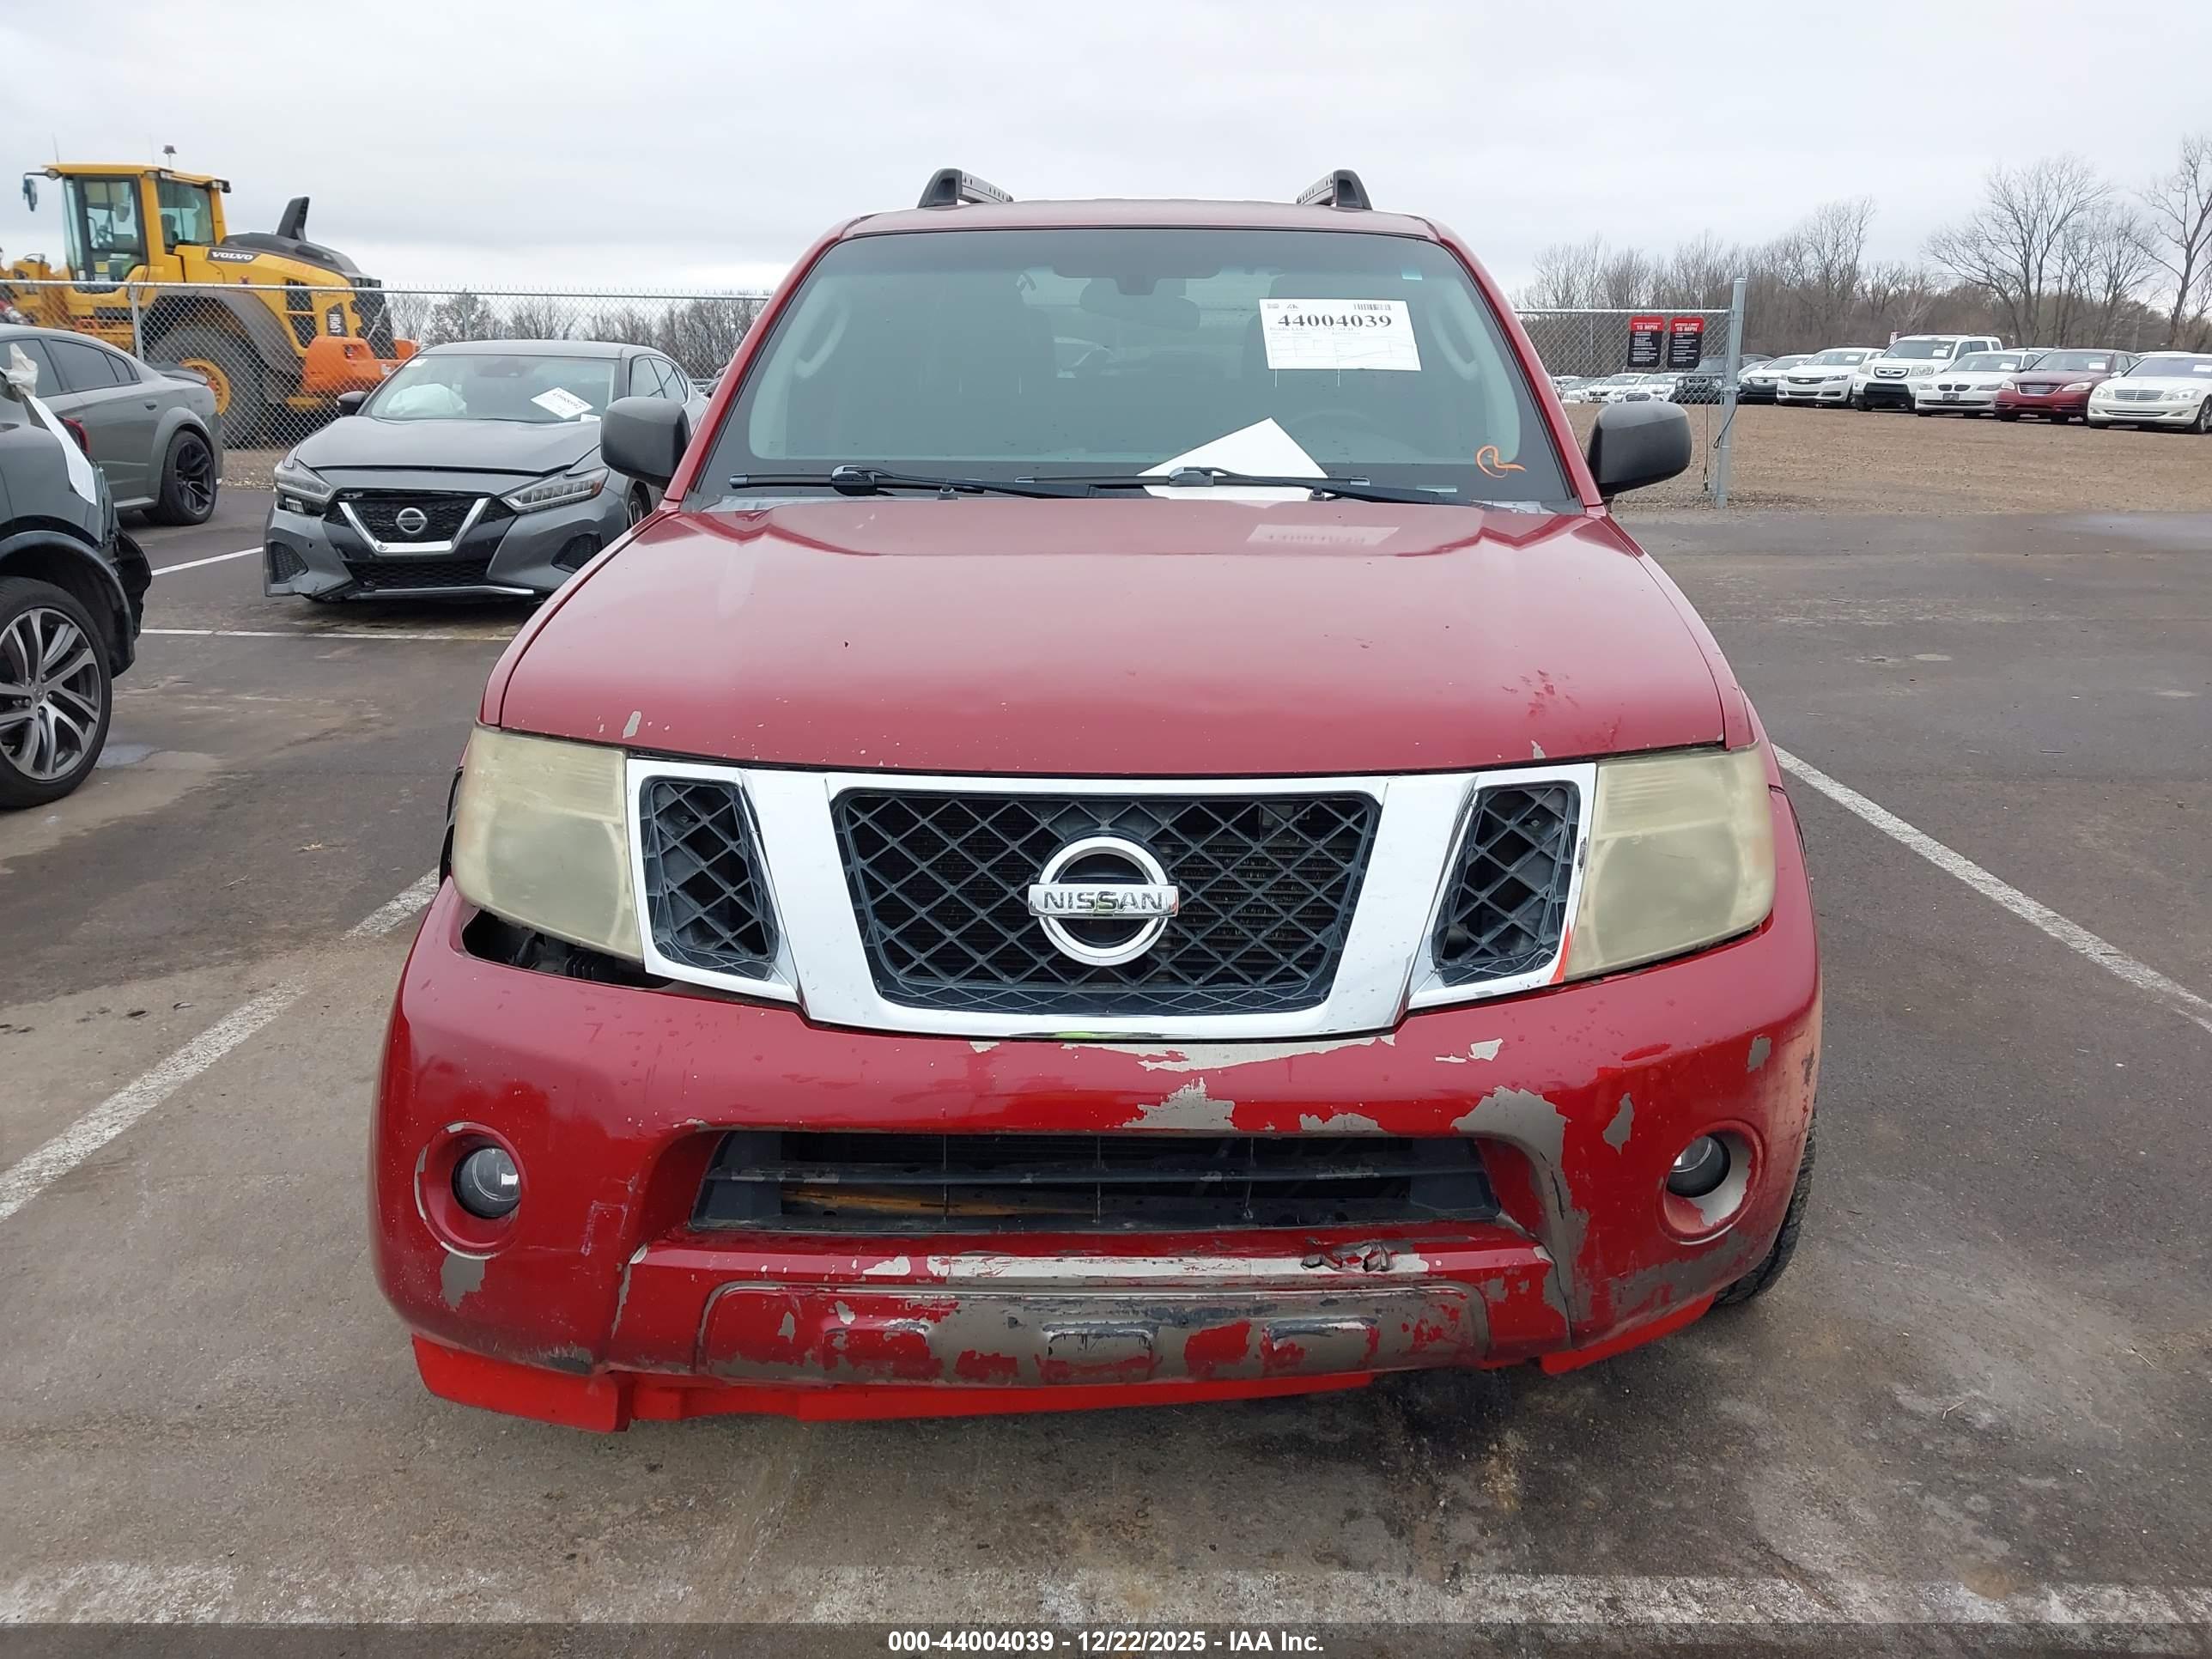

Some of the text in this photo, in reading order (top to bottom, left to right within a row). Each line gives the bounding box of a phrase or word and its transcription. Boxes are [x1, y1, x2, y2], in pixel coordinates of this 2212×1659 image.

[212, 252, 253, 260] VOLVO
[1278, 314, 1392, 327] 44004039
[1043, 890, 1163, 910] NISSAN
